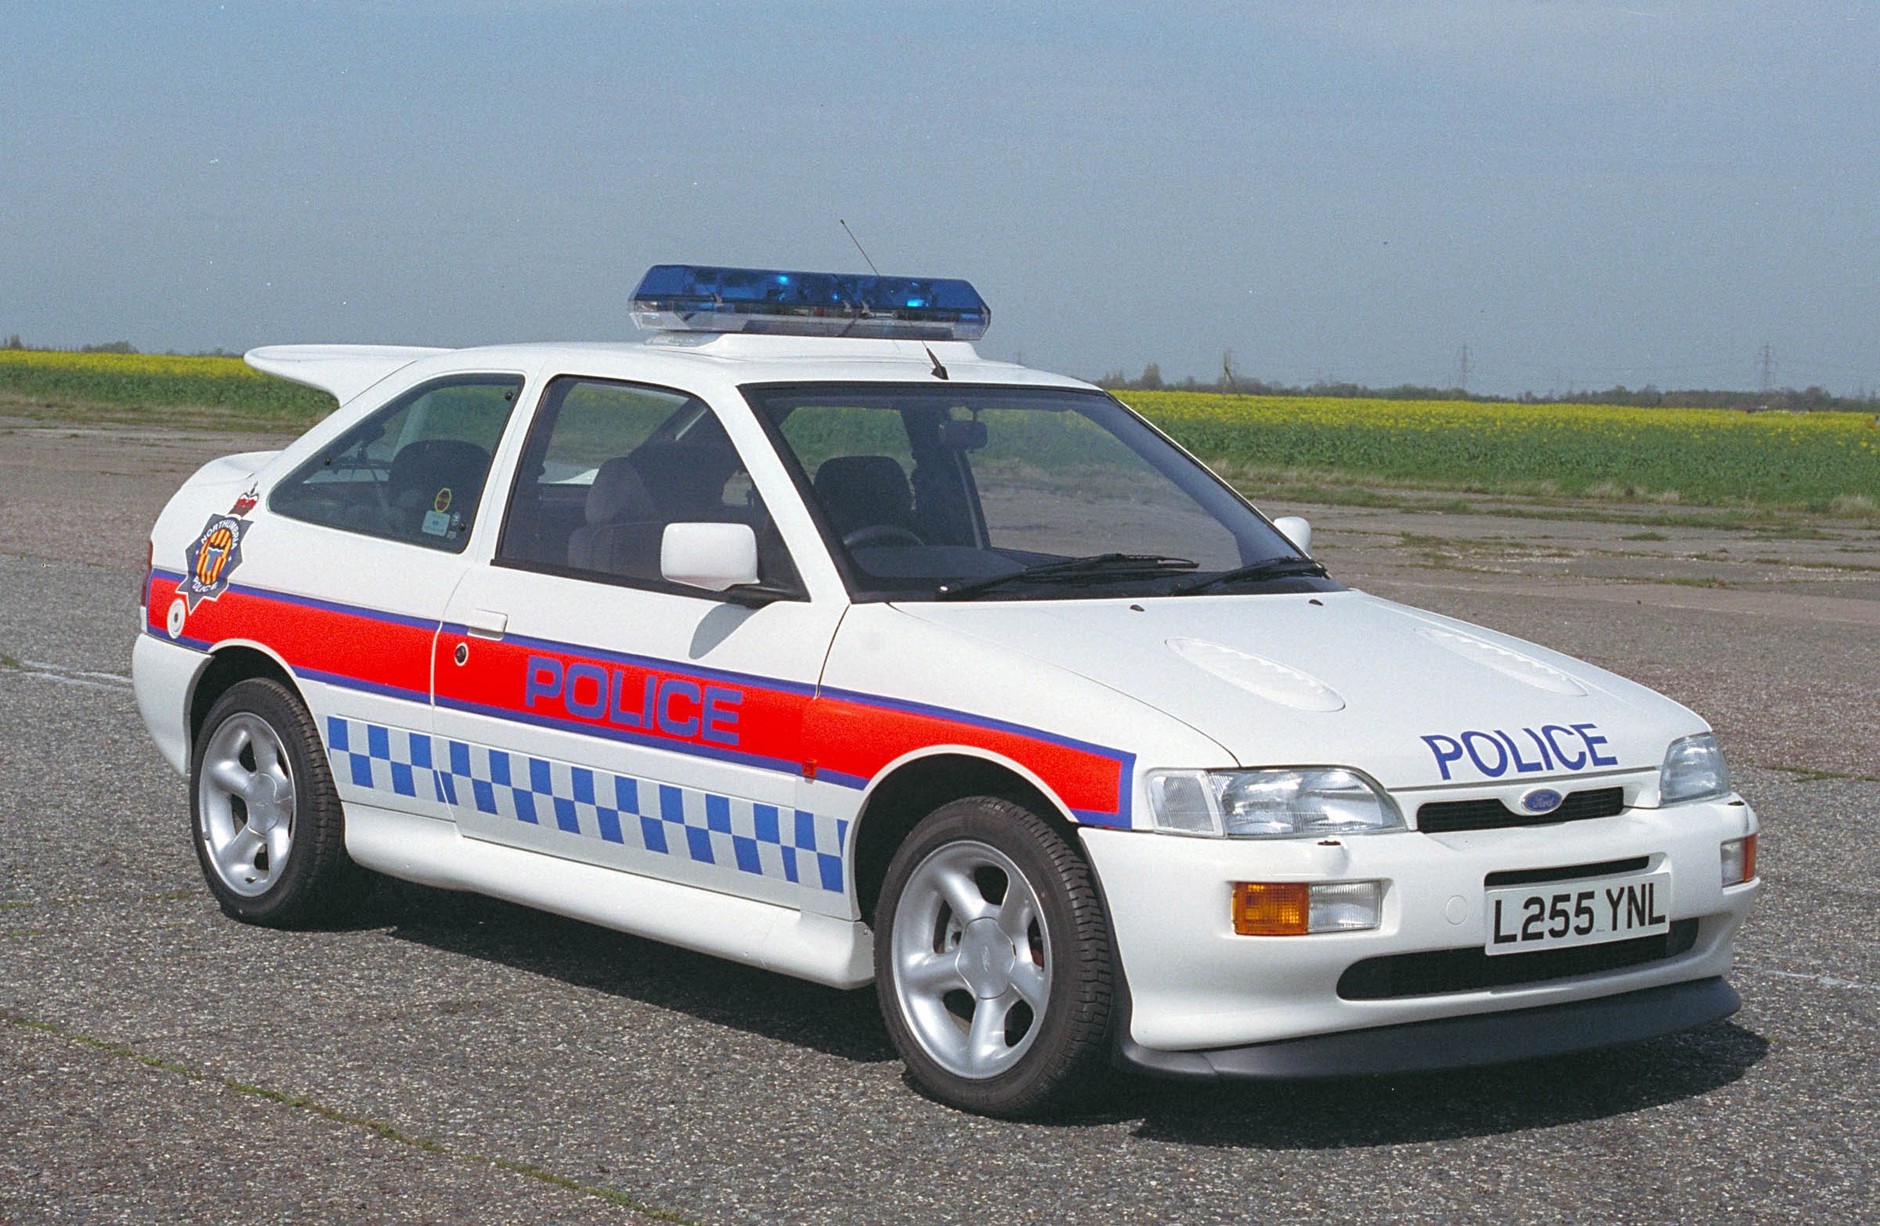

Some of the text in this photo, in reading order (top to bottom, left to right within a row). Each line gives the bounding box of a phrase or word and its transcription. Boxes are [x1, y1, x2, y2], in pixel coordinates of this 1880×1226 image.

[201, 519, 239, 551] NORTHUMBRIA
[192, 575, 218, 592] POLICE
[525, 655, 744, 746] POLICE
[1420, 723, 1618, 780] POLICE
[1493, 882, 1666, 944] L255 YNL
